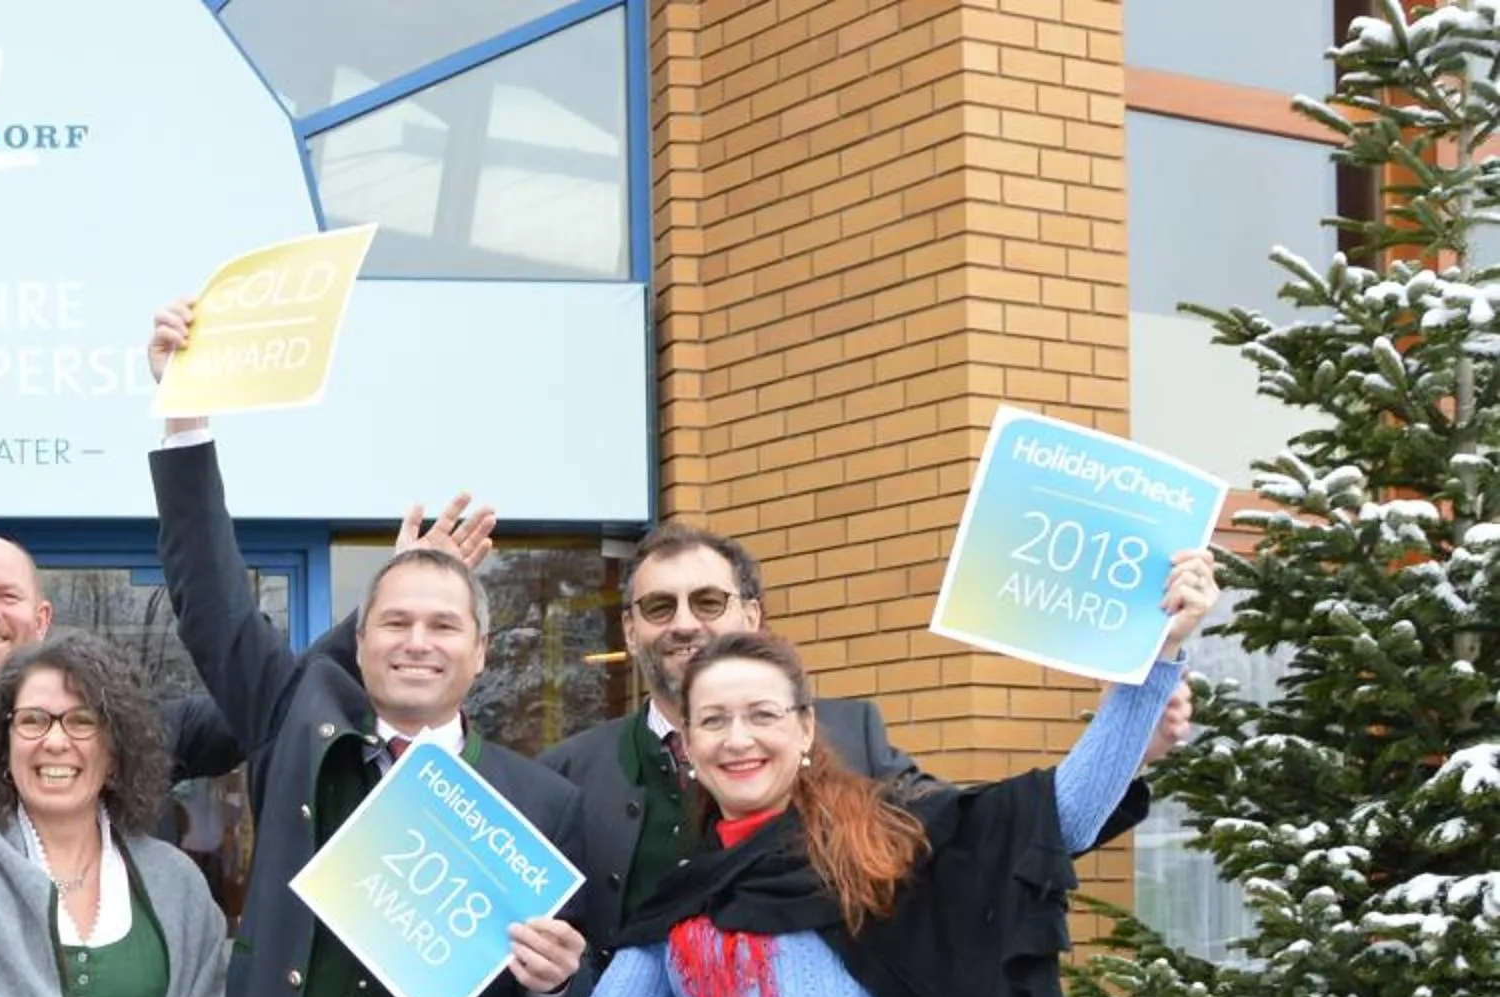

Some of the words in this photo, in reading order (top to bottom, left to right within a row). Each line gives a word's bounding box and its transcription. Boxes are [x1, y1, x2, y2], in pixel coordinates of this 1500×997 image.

[205, 260, 336, 314] GOLD
[1012, 435, 1196, 514] HolidayCheck
[1010, 511, 1148, 590] 2018
[997, 572, 1128, 631] AWARD
[418, 760, 549, 896] HolidayCheck
[355, 872, 451, 966] AWARD
[381, 829, 492, 939] 2018
